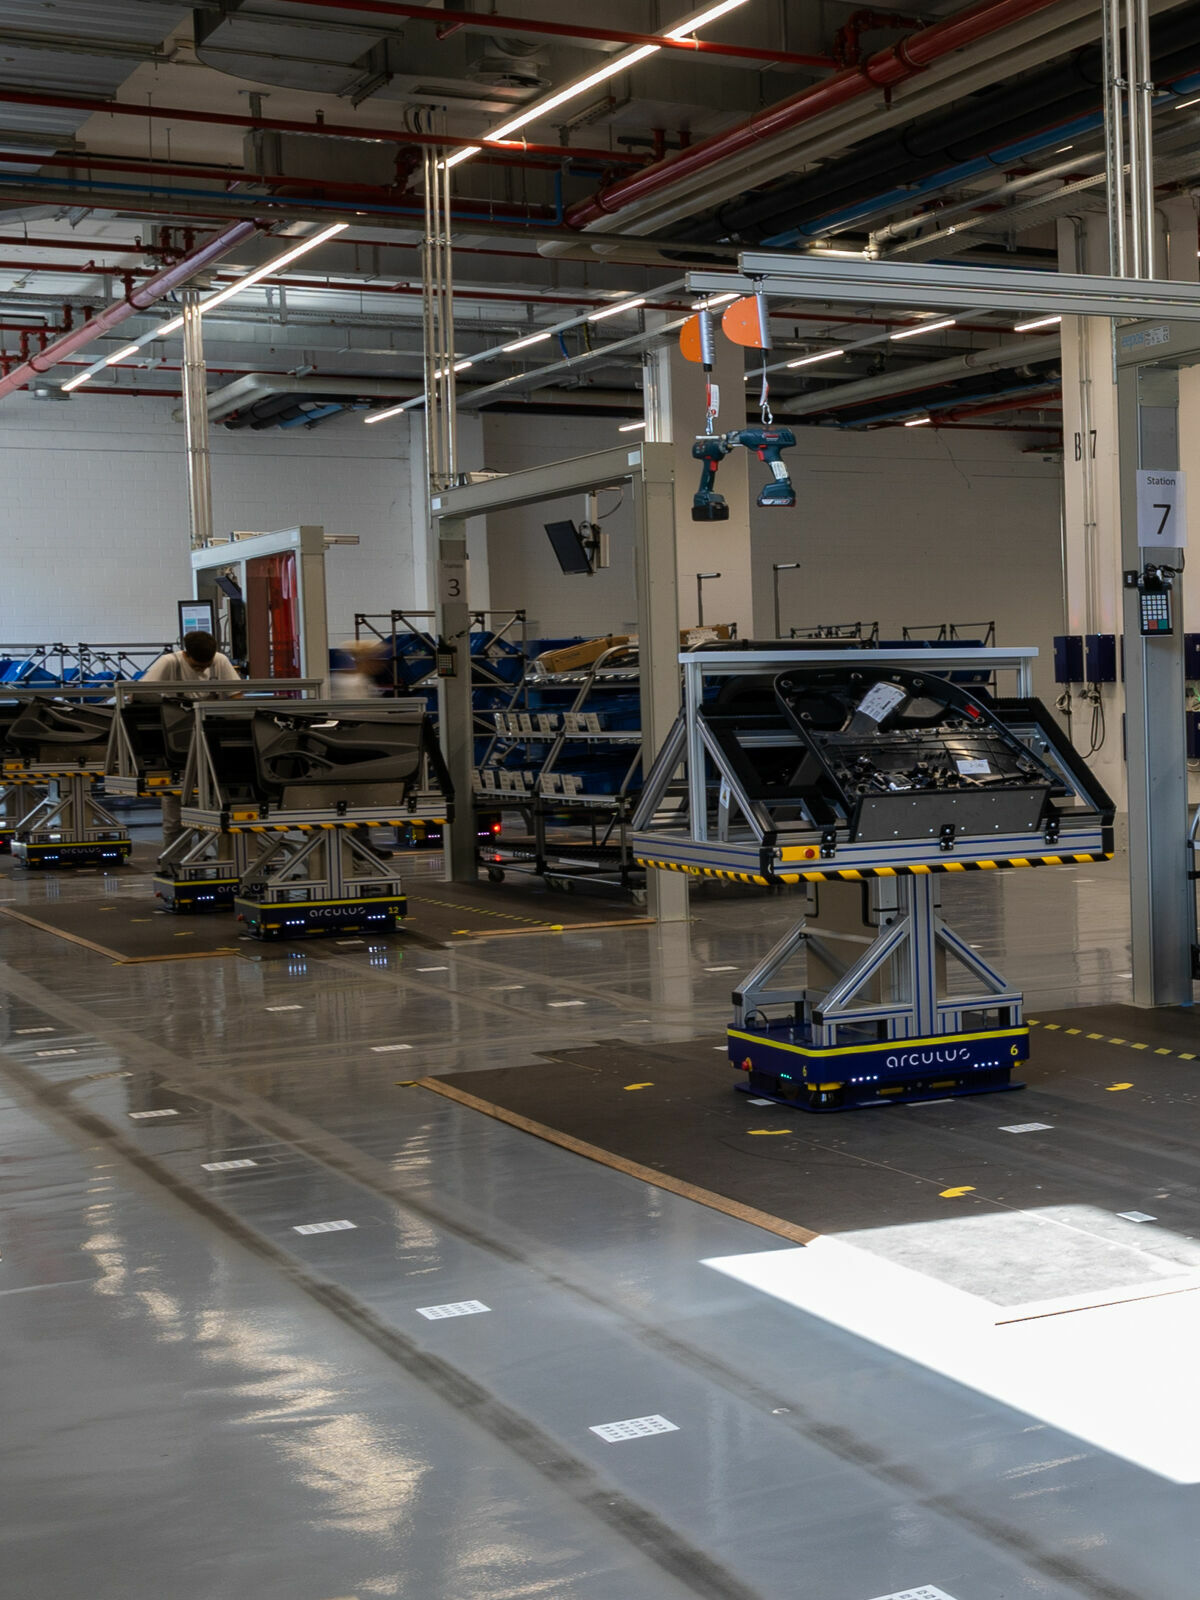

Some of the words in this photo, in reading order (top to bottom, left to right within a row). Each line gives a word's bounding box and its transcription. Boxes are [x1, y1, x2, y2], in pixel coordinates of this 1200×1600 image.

[1074, 431, 1082, 462] B
[1146, 476, 1176, 486] Station
[1153, 504, 1171, 534] 7
[447, 578, 461, 597] 3
[60, 847, 102, 855] arculus
[309, 905, 366, 918] arculus
[388, 906, 399, 914] 12
[886, 1048, 969, 1067] arculus
[1010, 1044, 1019, 1056] 6
